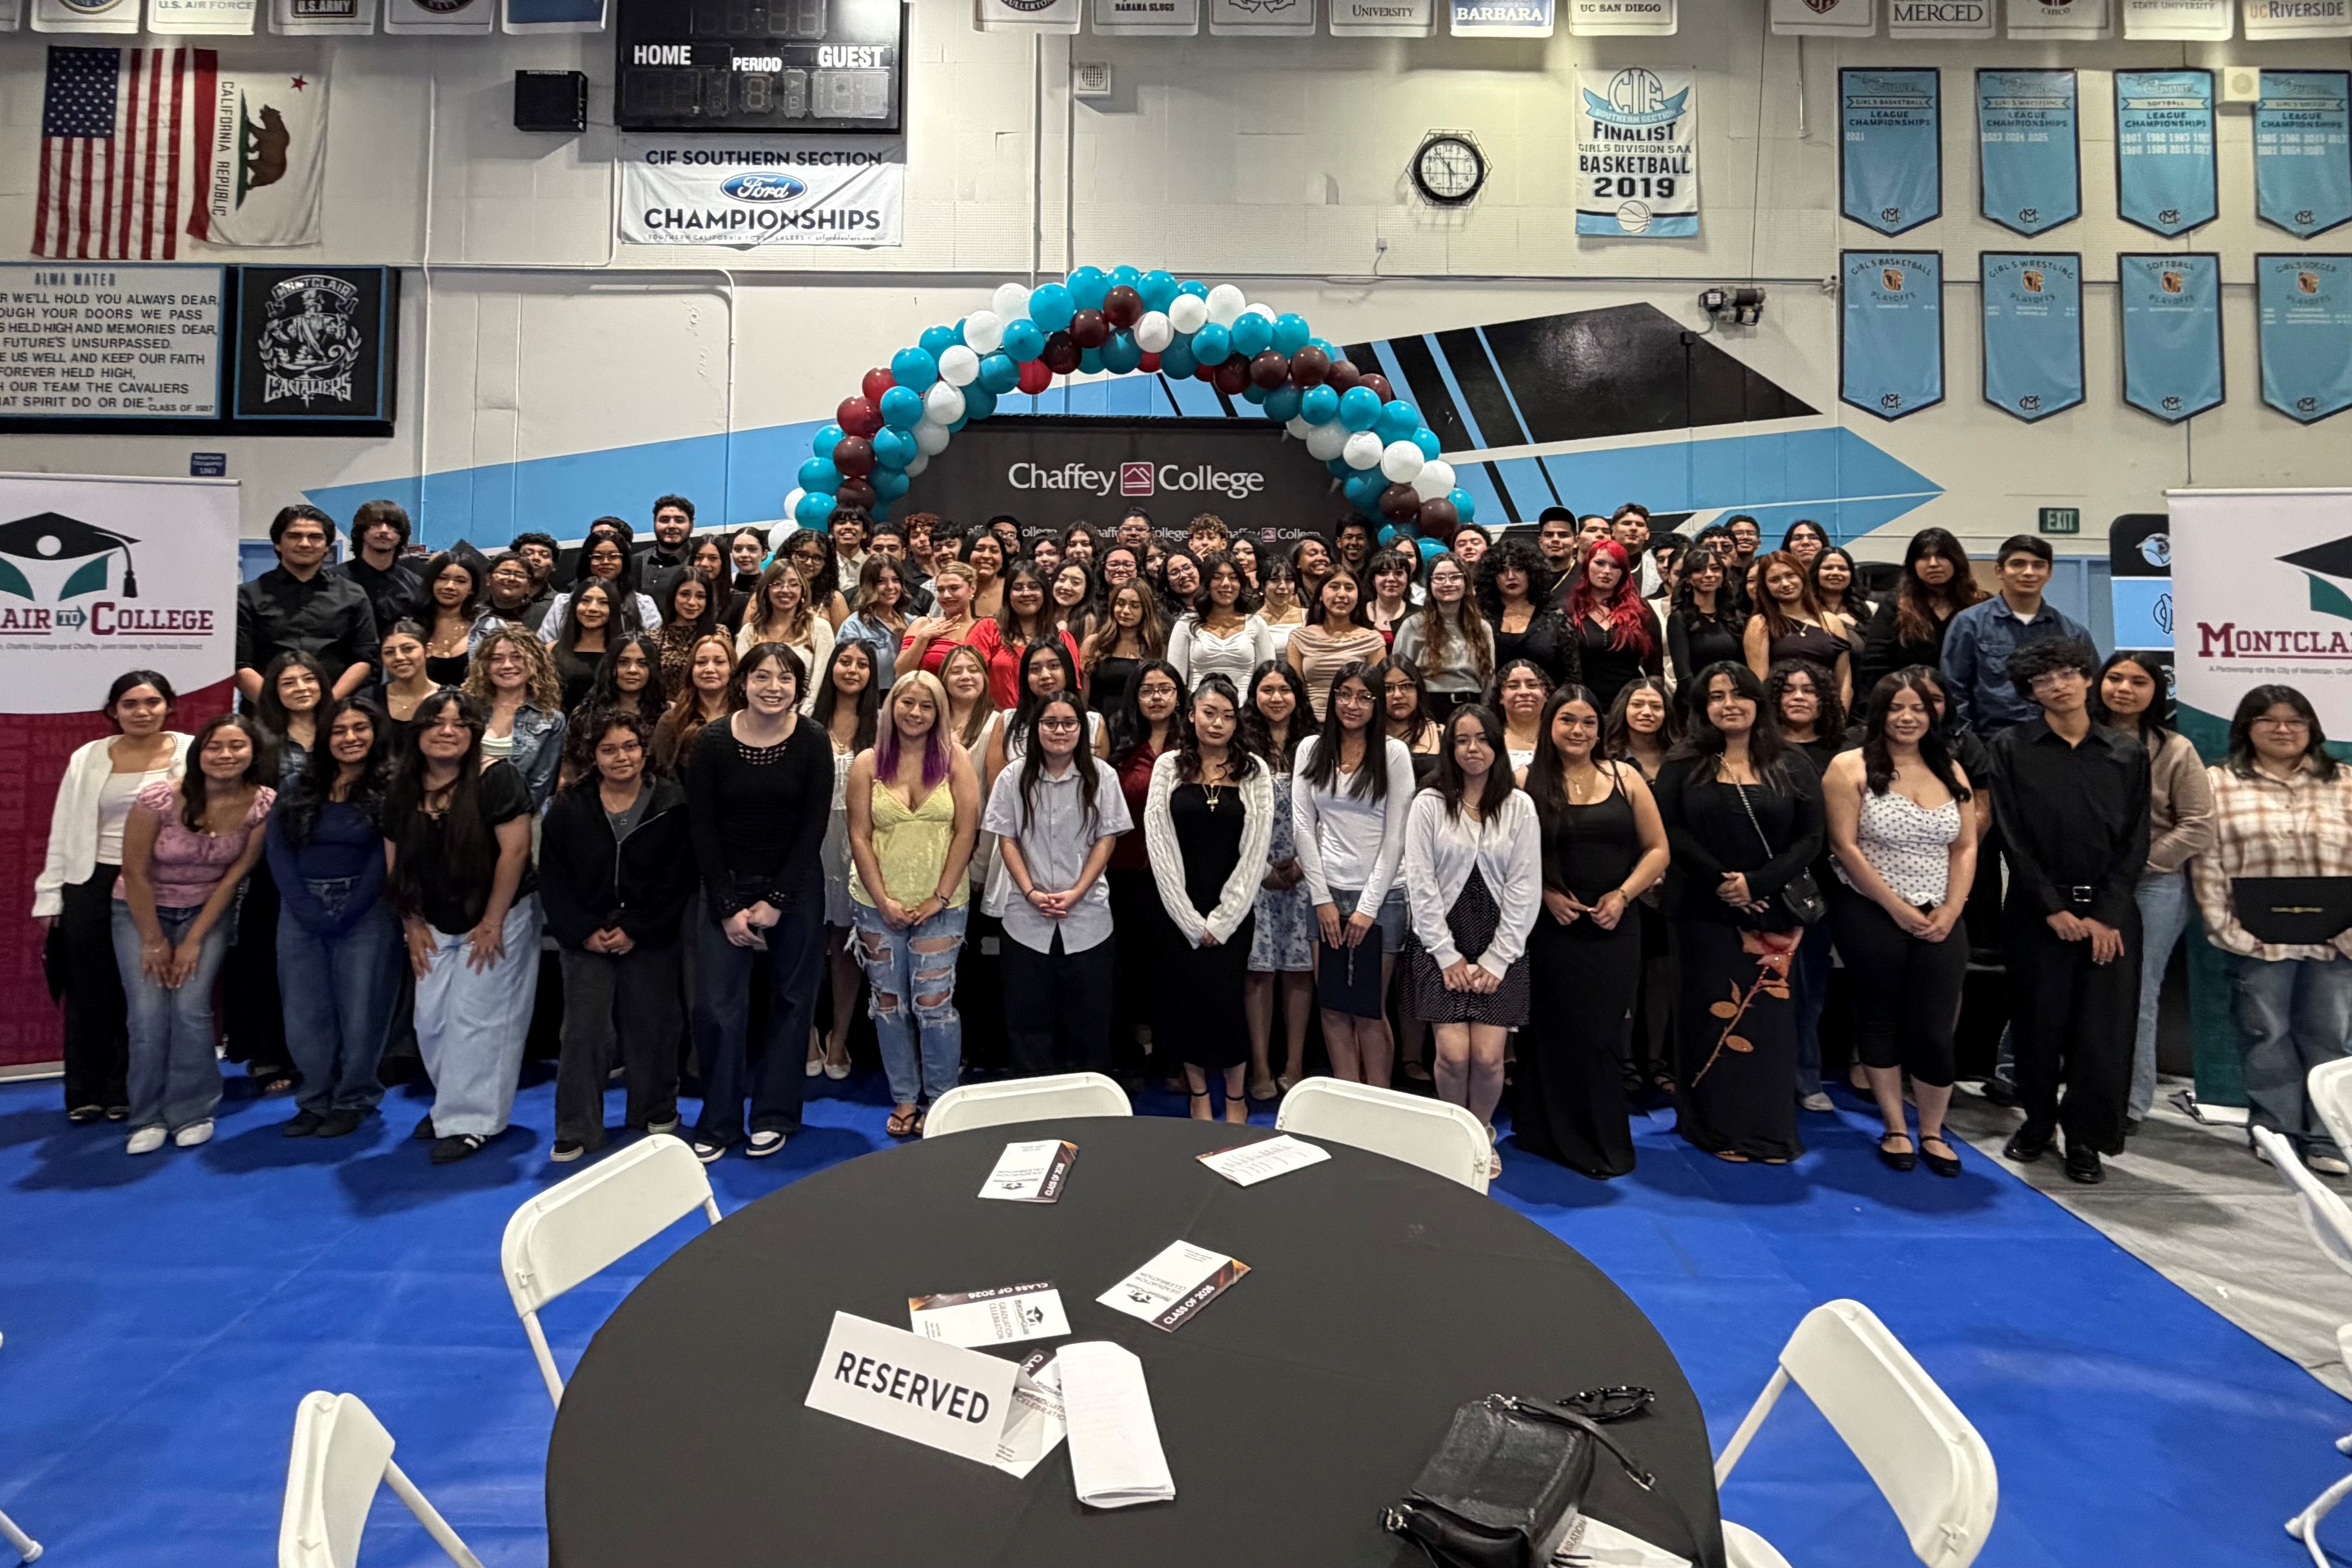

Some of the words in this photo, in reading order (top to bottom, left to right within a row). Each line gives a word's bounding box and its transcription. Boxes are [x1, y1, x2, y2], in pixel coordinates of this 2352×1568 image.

[1004, 0, 1050, 10] ULLERTO
[1115, 3, 1147, 11] BANANA
[1149, 3, 1175, 11] SLUGS
[1580, 3, 1595, 12] UC
[1599, 3, 1622, 12] SAN
[1625, 3, 1662, 13] DIEGO
[1893, 4, 1984, 22] MERCED
[2041, 7, 2071, 16] CHICO
[1456, 7, 1543, 21] BARBARA
[634, 45, 691, 65] HOME
[818, 46, 885, 68] GUEST
[732, 57, 782, 72] PERIOD
[1608, 67, 1663, 114] CIF
[217, 81, 234, 152] CALIFORNIA
[1594, 108, 1639, 123] SOUTHERN
[1641, 109, 1677, 122] SECTION
[2125, 119, 2207, 128] CHAMPIONSHIPS
[1593, 120, 1676, 141] FINALIST
[1578, 144, 1611, 153] GIRLS
[1614, 144, 1664, 153] DIVISION
[645, 150, 677, 165] CIF
[683, 150, 790, 167] SOUTHERN
[796, 151, 883, 167] SECTION
[1579, 155, 1691, 174] BASKETBALL
[211, 161, 231, 216] REPUBLIC
[737, 176, 791, 199] Ford
[1594, 177, 1675, 198] 2019
[644, 208, 881, 230] CHAMPIONSHIPS
[1878, 258, 1933, 276] BASKETBALL
[2019, 260, 2074, 279] WRESTLING
[2146, 260, 2195, 271] SOFTBALL
[35, 273, 66, 285] ALMA
[73, 273, 116, 287] MATER
[276, 277, 352, 298] MONTCLAIR
[54, 293, 90, 305] HOLD
[95, 293, 122, 305] YOU
[127, 294, 176, 305] ALWAYS
[41, 308, 78, 319] YOUR
[85, 308, 133, 320] DOORS
[141, 309, 162, 319] WE
[169, 310, 202, 320] PASS
[8, 322, 41, 333] HELD
[43, 322, 73, 333] HIGH
[75, 323, 103, 334] AND
[107, 323, 176, 334] MEMORIES
[11, 352, 28, 362] US
[33, 352, 66, 363] WELL
[70, 353, 98, 363] AND
[101, 353, 135, 363] KEEP
[139, 353, 166, 365] OUR
[169, 354, 205, 365] FAITH
[61, 367, 95, 378] HELD
[10, 381, 38, 392] OUR
[43, 382, 80, 393] TEAM
[86, 382, 113, 393] THE
[118, 382, 189, 394] CAVALIERS
[263, 371, 353, 404] CAVALIERS
[23, 396, 66, 407] SPIRIT
[72, 397, 91, 408] DO
[98, 397, 117, 408] OR
[147, 404, 177, 412] CLASS
[1008, 463, 1117, 496] Chaffey
[1158, 464, 1265, 499] College
[2046, 510, 2074, 530] EXIT
[1152, 526, 1189, 542] ollege
[58, 611, 81, 625] TO
[91, 601, 214, 636] COLLEGE
[2197, 622, 2352, 658] MONTCLA
[1044, 1181, 1058, 1196] CLASS
[968, 1289, 995, 1299] 2026
[1014, 1283, 1049, 1293] CLASS
[1163, 1304, 1189, 1325] CLASS
[1185, 1297, 1198, 1308] OF
[1195, 1284, 1216, 1301] 2026
[834, 1350, 990, 1424] RESERVED
[1016, 1396, 1066, 1421] CELEBRATIO
